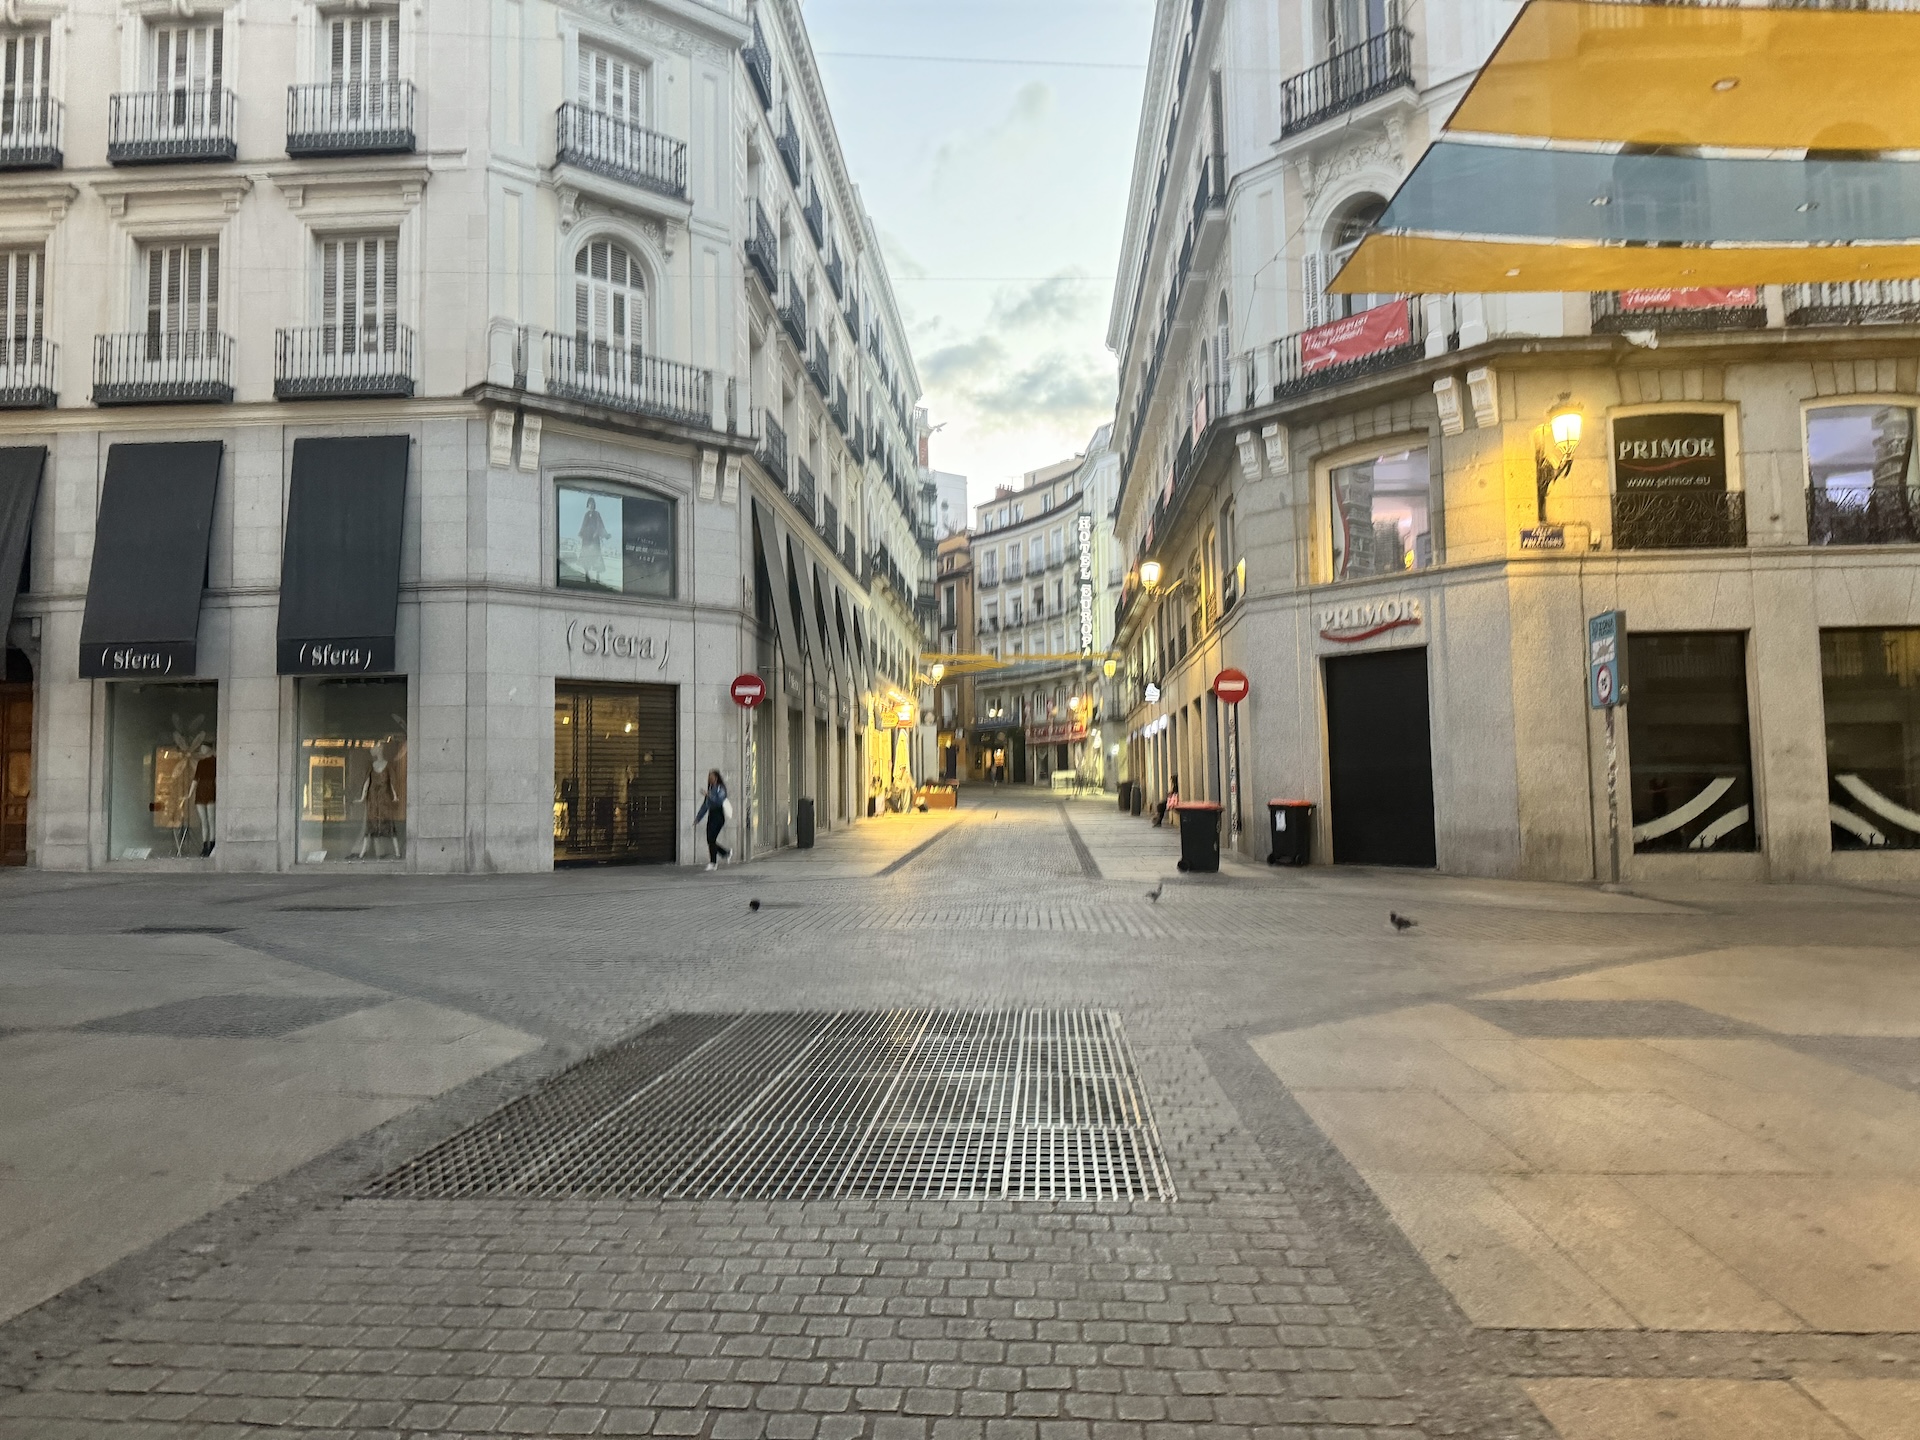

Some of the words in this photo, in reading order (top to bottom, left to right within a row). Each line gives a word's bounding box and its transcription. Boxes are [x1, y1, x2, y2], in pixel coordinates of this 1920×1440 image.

[1619, 437, 1716, 460] PRIMOR
[1626, 475, 1711, 488] www.primor.eu
[1078, 515, 1092, 581] HOTEL
[1080, 583, 1092, 659] EUROPA
[1319, 597, 1421, 630] PRIMOR
